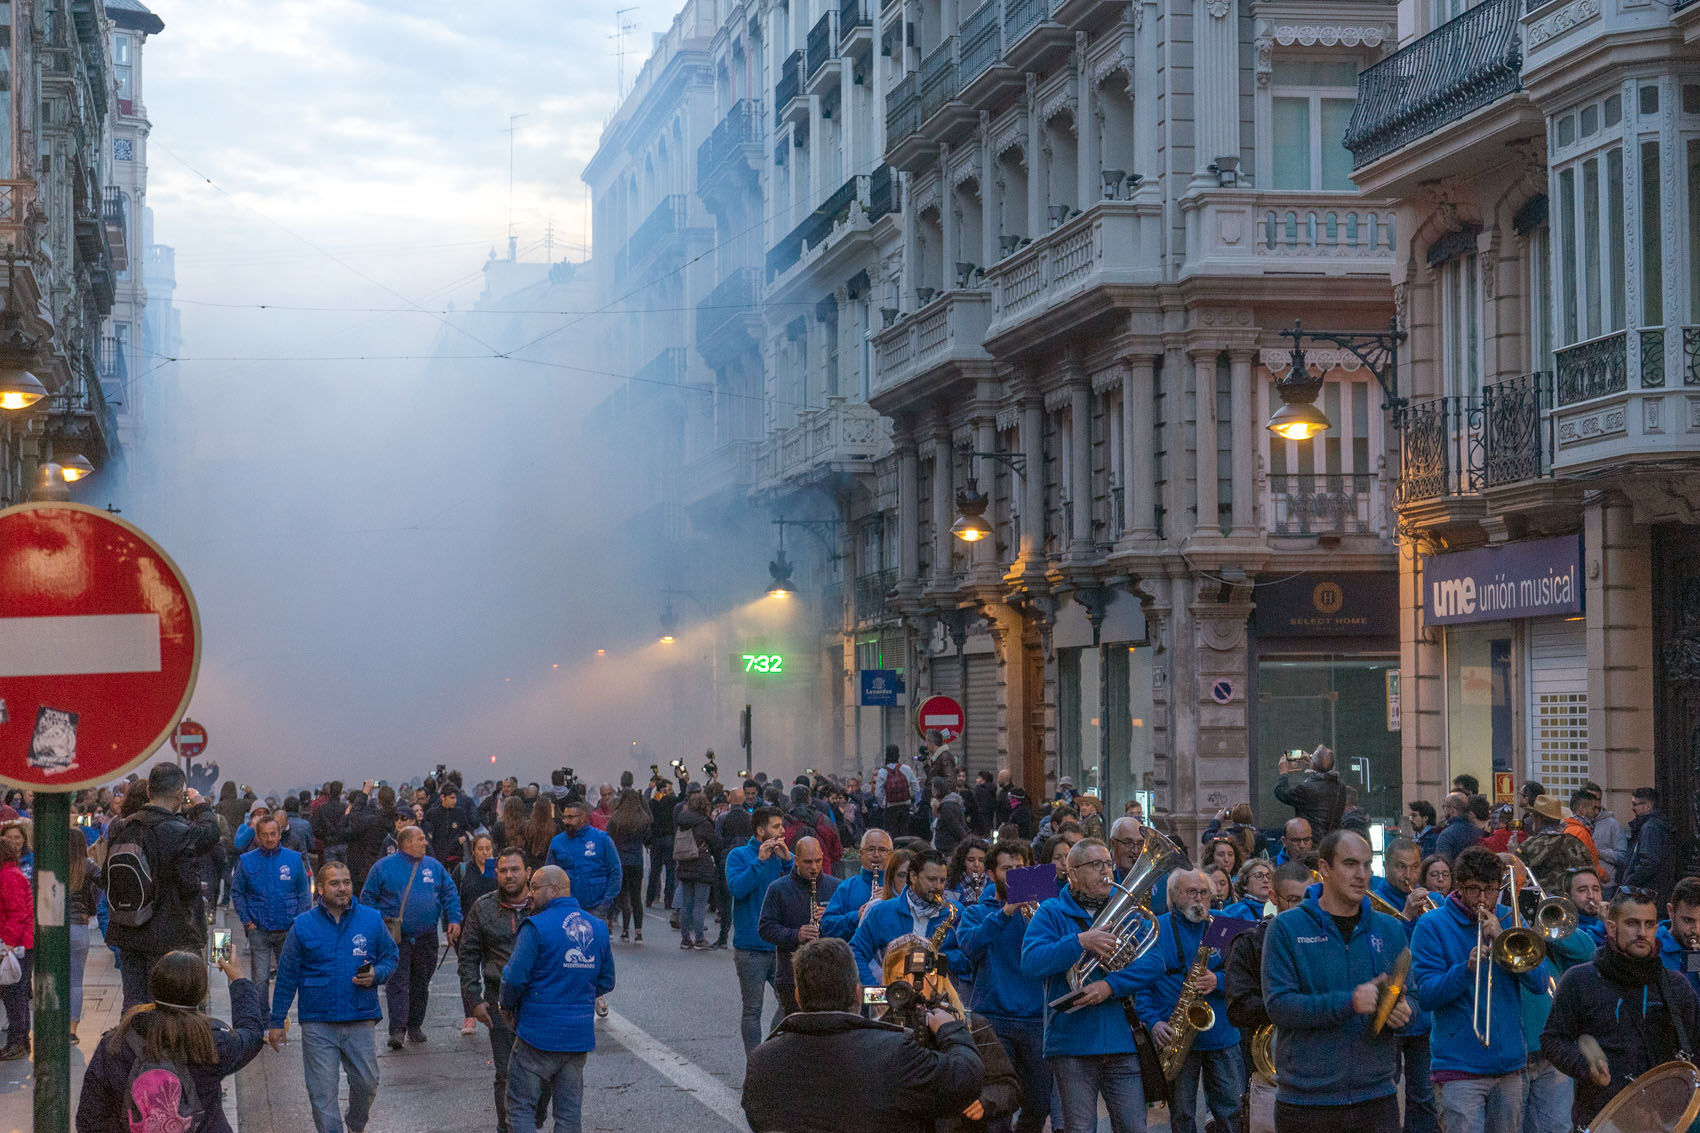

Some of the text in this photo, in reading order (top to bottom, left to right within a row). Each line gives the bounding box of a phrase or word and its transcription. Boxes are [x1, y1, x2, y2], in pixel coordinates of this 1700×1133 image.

[1433, 564, 1575, 617] ume unión musical
[1290, 617, 1368, 625] SELECT HOME
[742, 654, 783, 673] 7:32
